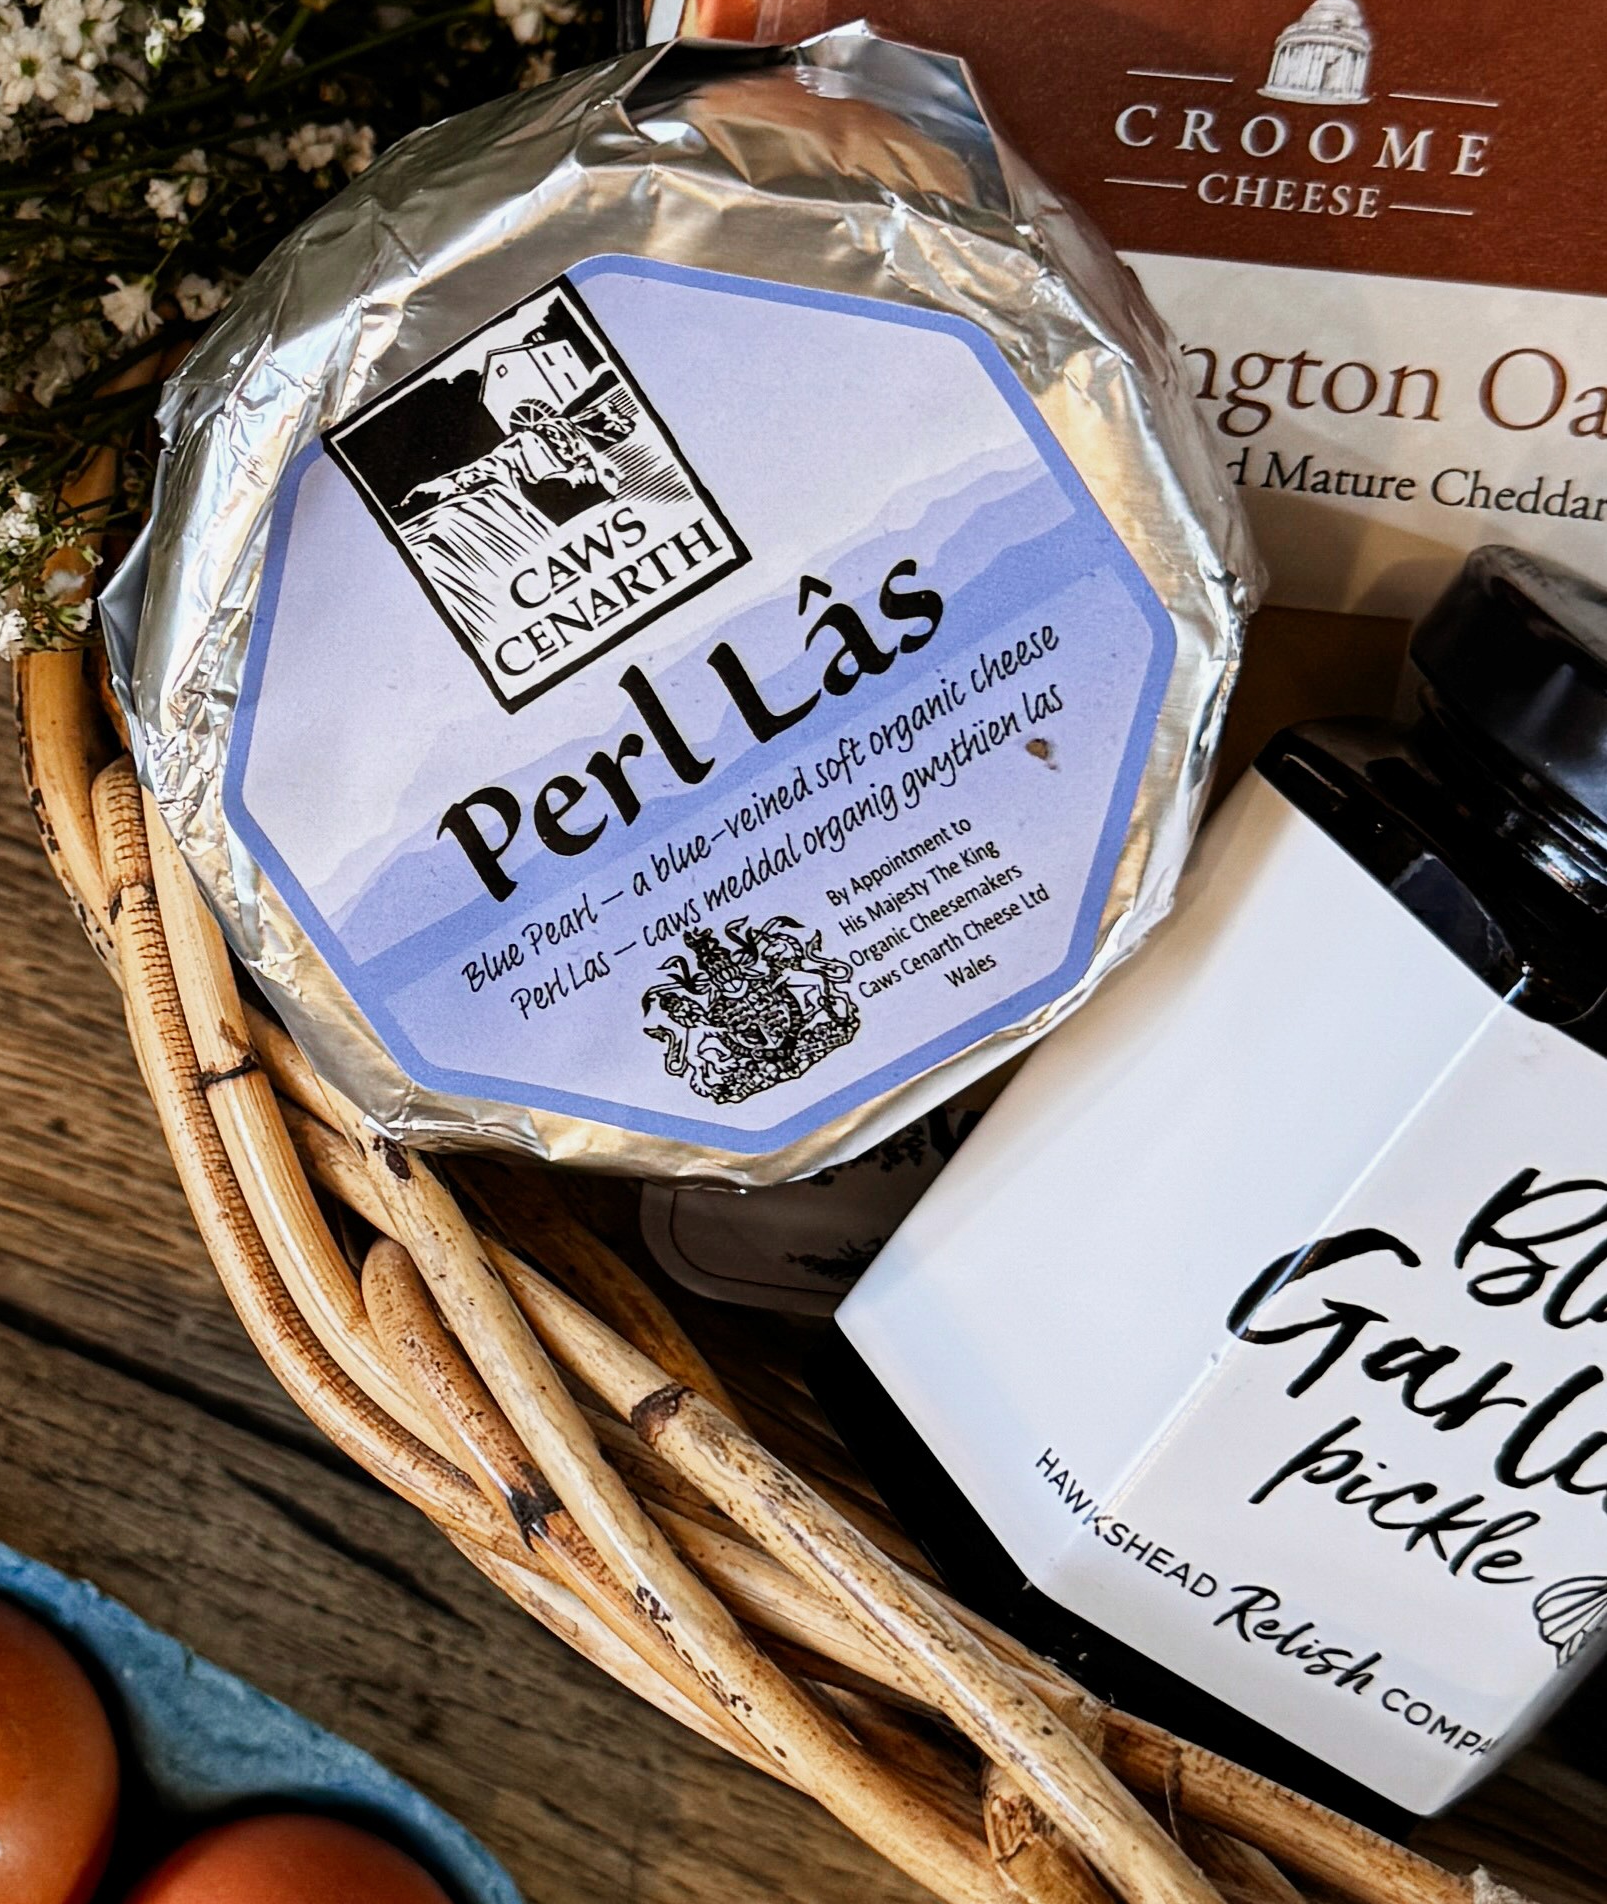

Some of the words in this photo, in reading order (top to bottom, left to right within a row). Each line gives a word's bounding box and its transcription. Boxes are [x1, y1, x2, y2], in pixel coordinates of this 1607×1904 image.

[1114, 105, 1491, 178] CROOME
[1196, 173, 1381, 219] CHEESE
[1180, 343, 1440, 437] ngton
[1479, 348, 1607, 440] Oa
[1261, 451, 1416, 501] Mature
[1432, 468, 1607, 522] Cheddar
[495, 518, 723, 676] CENARTH
[510, 506, 647, 609] CAWS
[436, 664, 716, 902] Perl
[706, 559, 944, 743] Lâs
[461, 944, 524, 993] Blue
[522, 893, 598, 954] Pearl
[633, 872, 652, 896] a
[816, 738, 865, 788] soft
[870, 678, 966, 753] organic
[971, 625, 1059, 693] cheese
[510, 968, 568, 1020] Perl
[568, 950, 610, 990] Las
[643, 897, 701, 946] caws
[703, 833, 801, 911] meddal
[803, 783, 898, 853] organig
[1022, 684, 1063, 724] las
[826, 887, 851, 907] By
[850, 827, 953, 894] Appointment
[951, 818, 972, 836] to
[838, 914, 868, 937] His
[865, 879, 930, 922] Majesty
[926, 860, 962, 885] The
[959, 840, 1001, 867] King
[849, 927, 911, 967] Organic
[910, 864, 1023, 933] Cheesemakers
[859, 968, 901, 998] Caws
[900, 933, 965, 975] Cenarth
[963, 903, 1022, 942] Cheese
[1019, 883, 1051, 910] Ltd
[944, 953, 997, 988] Wales
[1455, 1167, 1607, 1330] Bl
[1226, 1227, 1607, 1501] Garli
[1248, 1416, 1534, 1584] pickle
[1035, 1447, 1218, 1598] HAWKSHEAD
[1213, 1585, 1382, 1695] Relish
